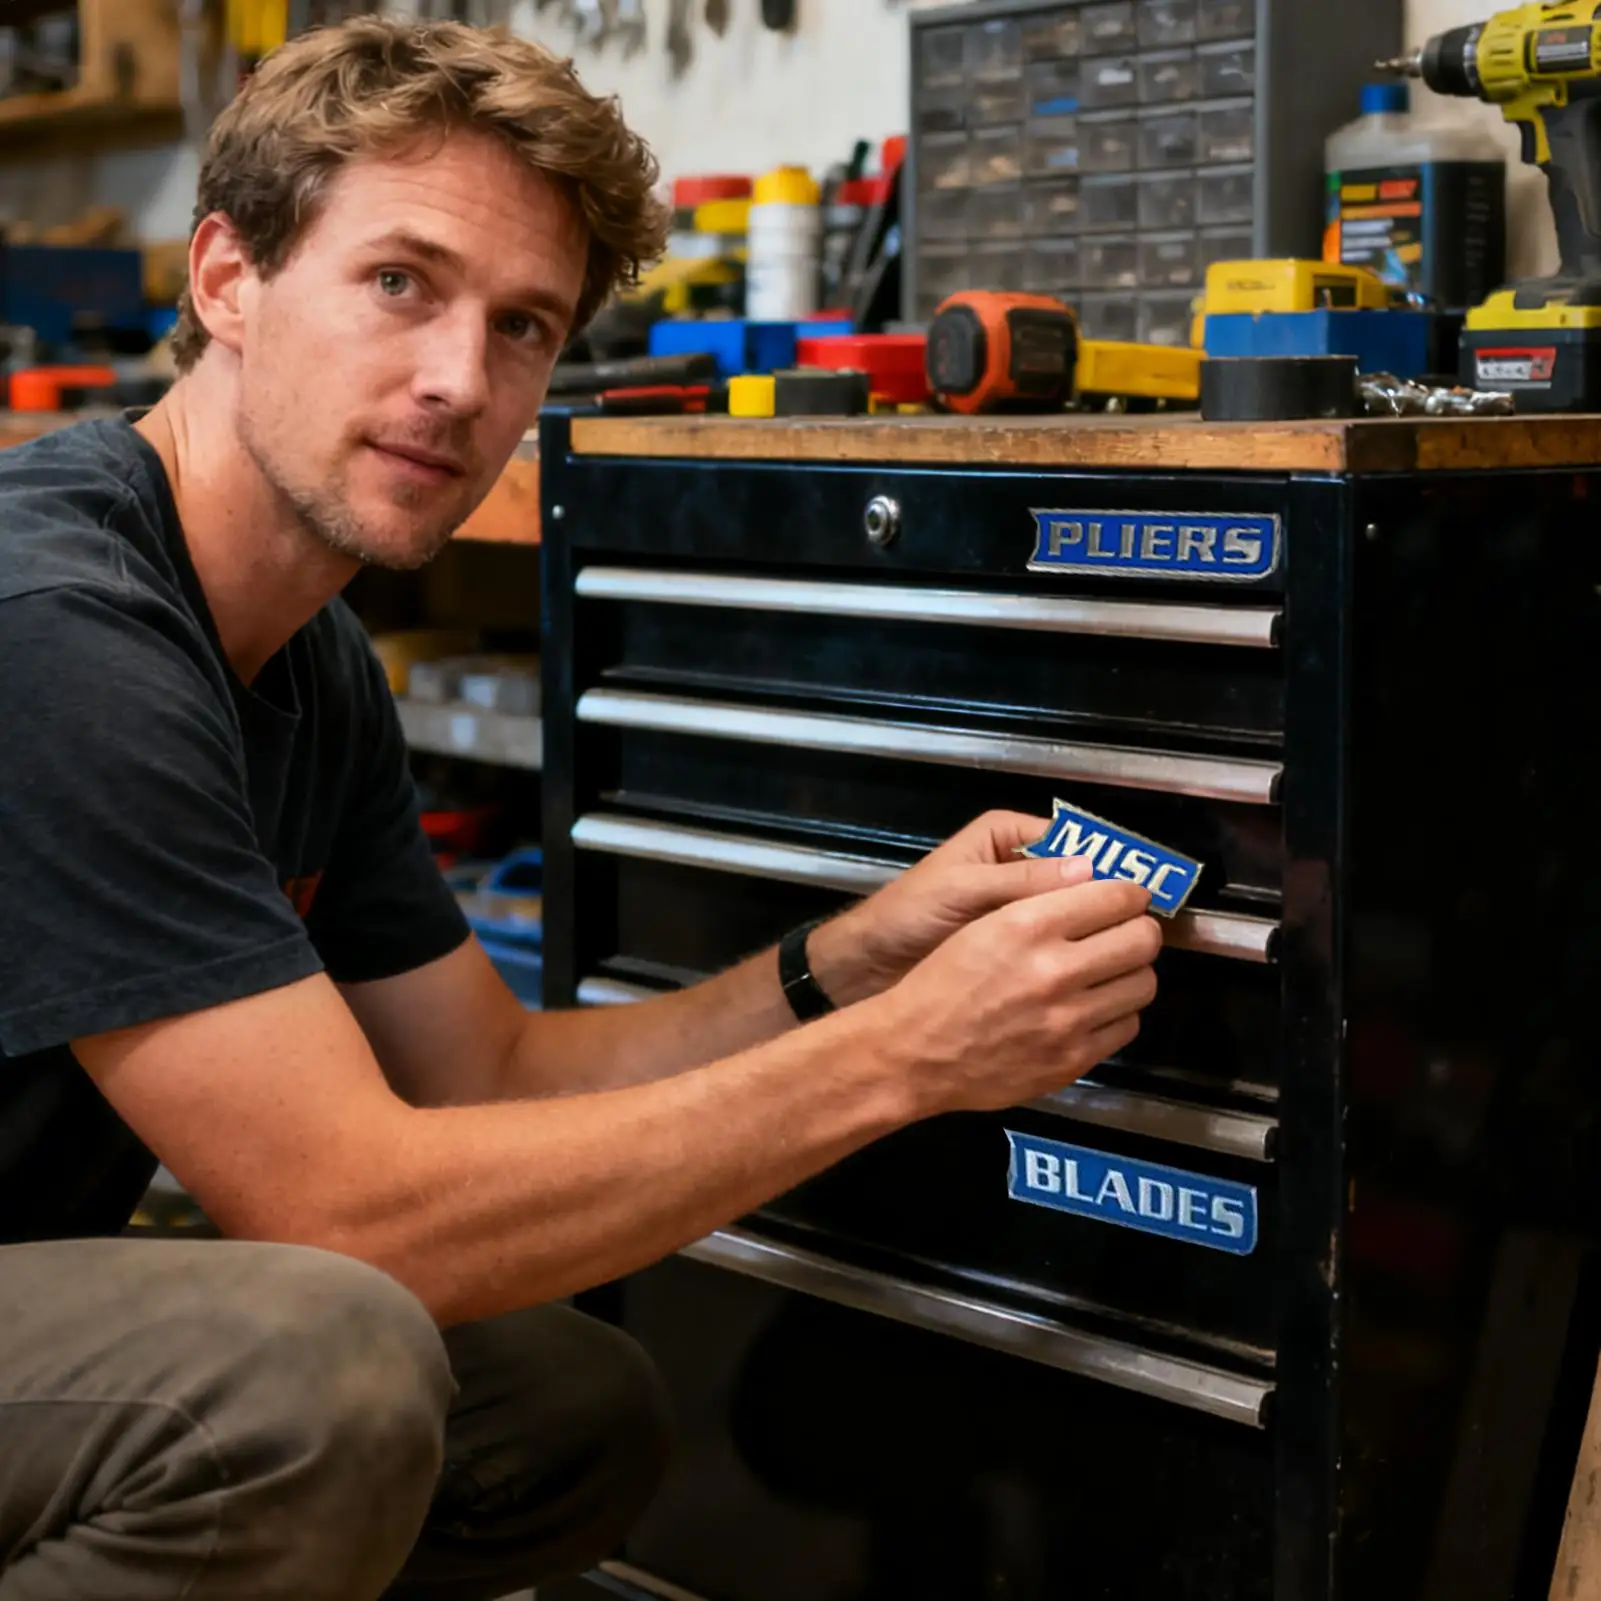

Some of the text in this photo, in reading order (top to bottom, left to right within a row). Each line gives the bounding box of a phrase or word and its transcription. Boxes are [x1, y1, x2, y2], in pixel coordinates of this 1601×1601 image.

[1048, 520, 1262, 564] PLIERS
[1048, 819, 1188, 900] MISC
[1024, 1148, 1245, 1239] BLADES
